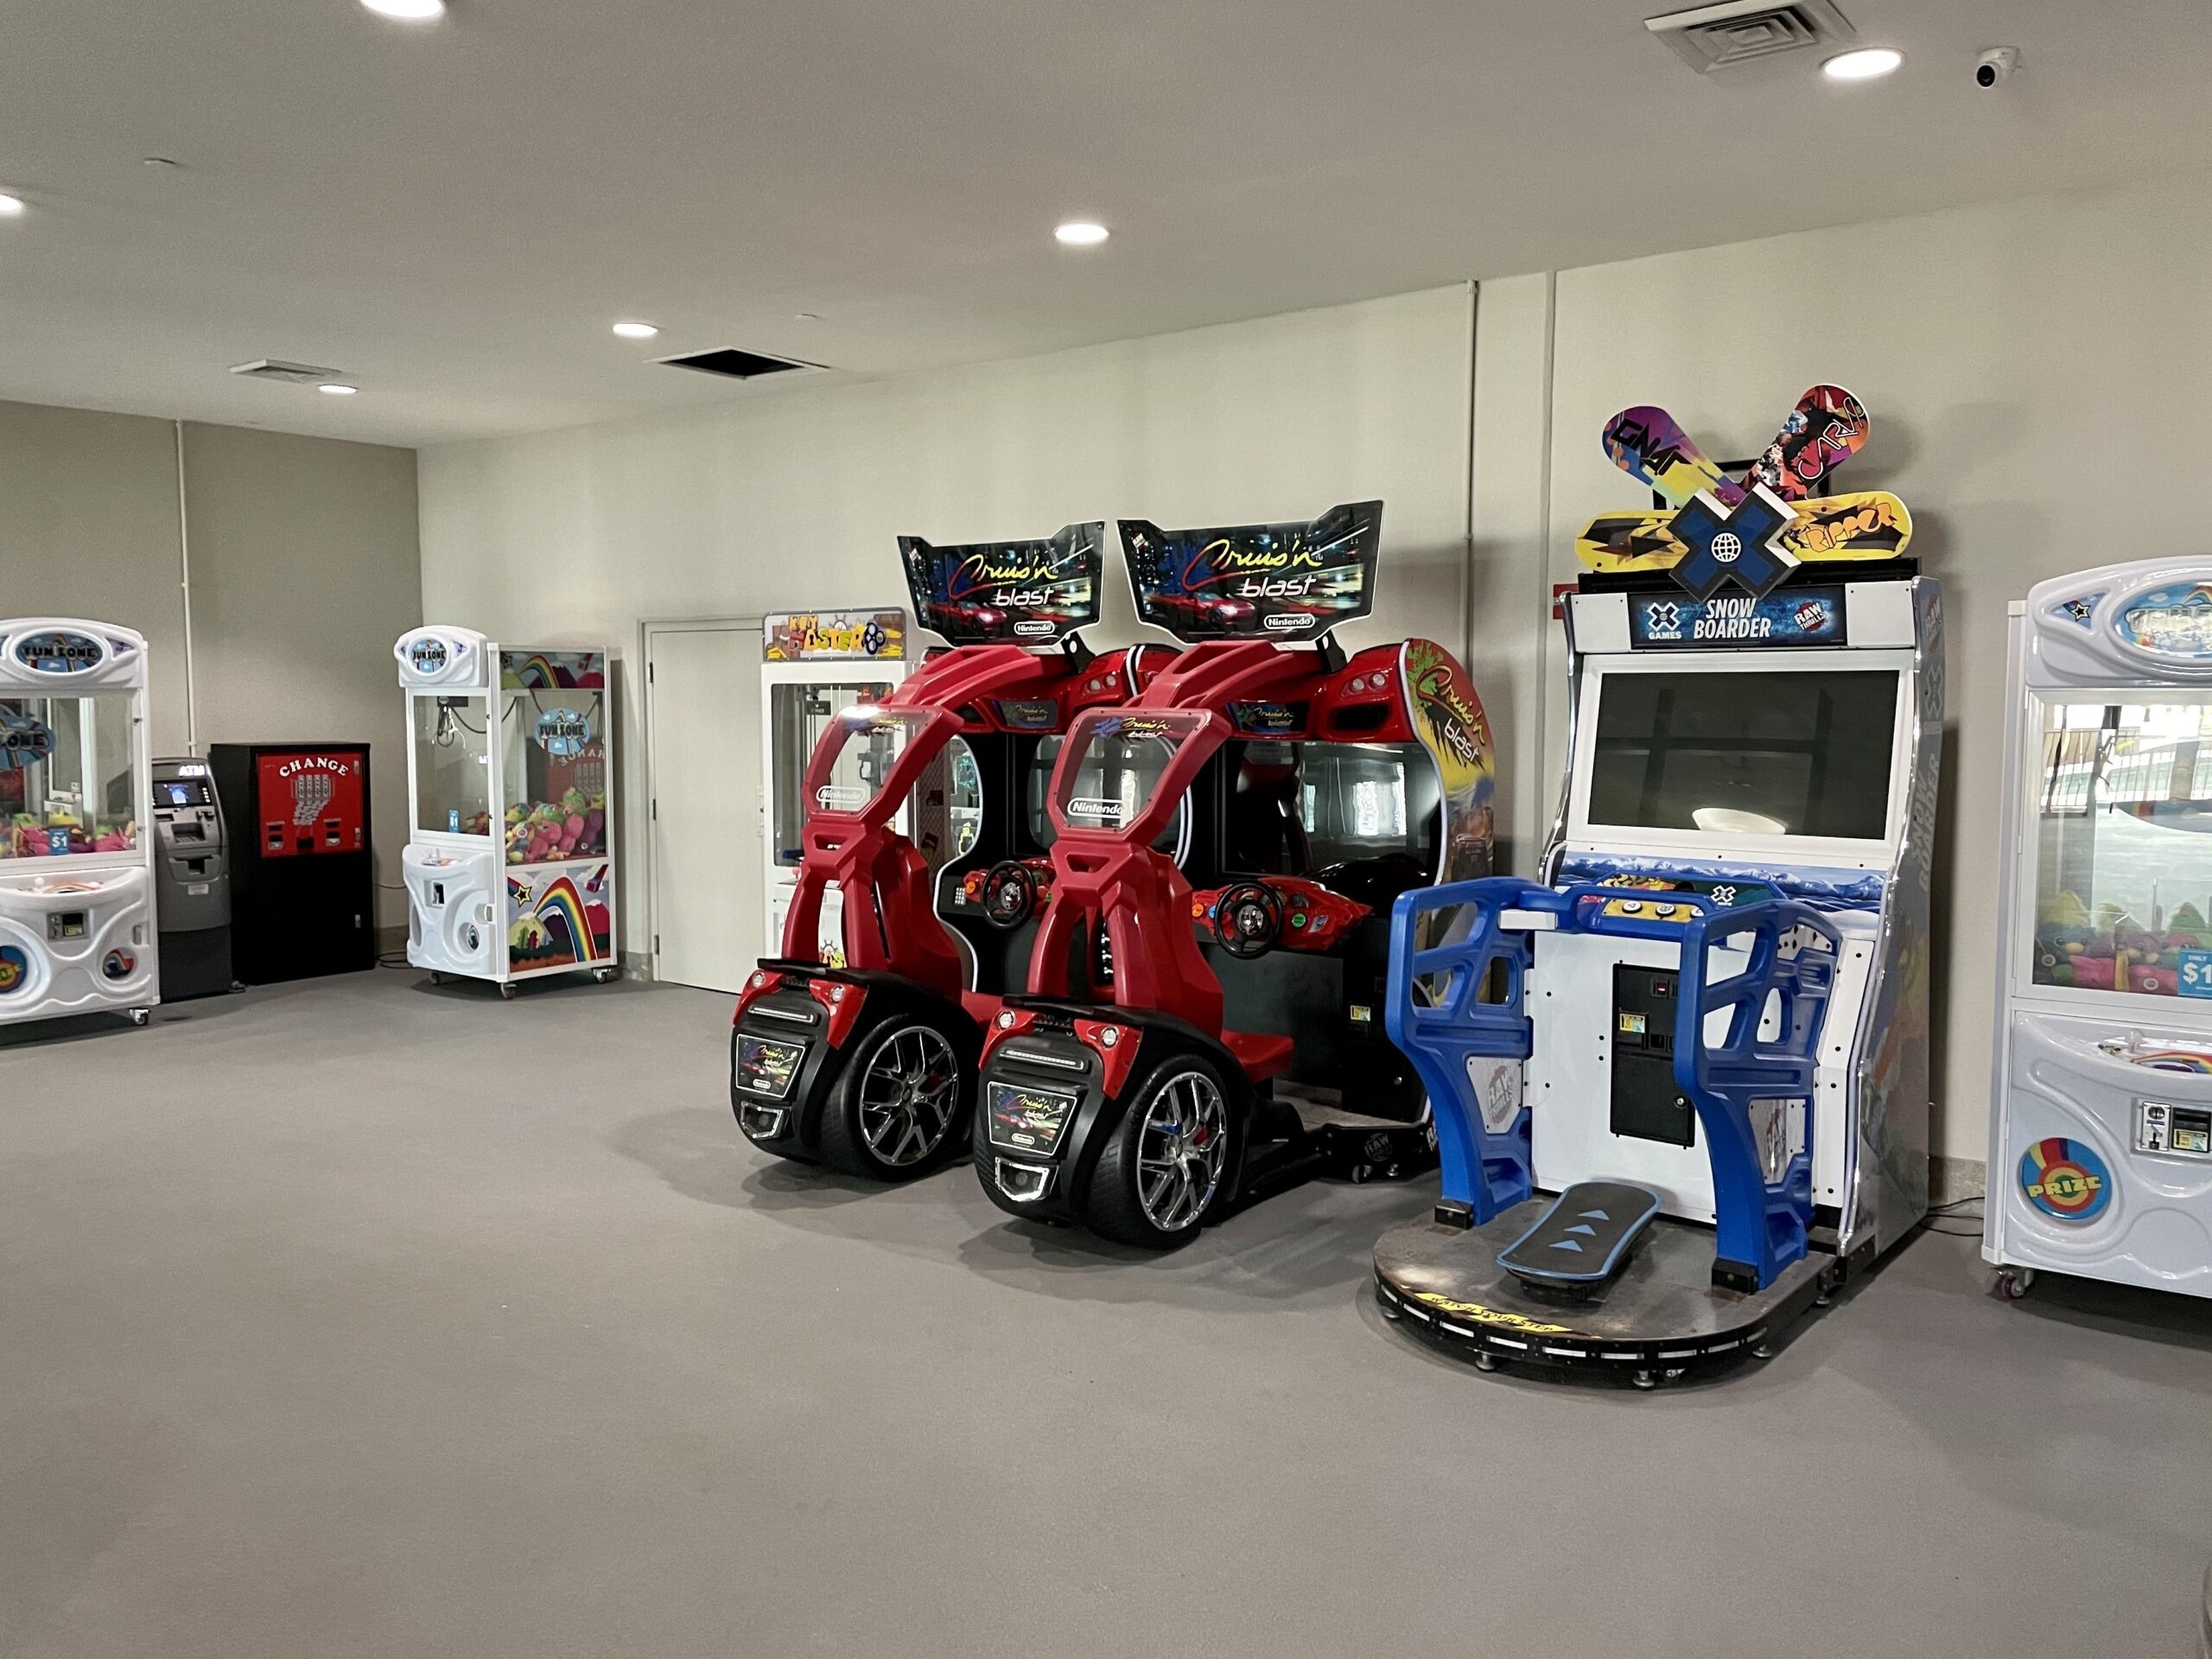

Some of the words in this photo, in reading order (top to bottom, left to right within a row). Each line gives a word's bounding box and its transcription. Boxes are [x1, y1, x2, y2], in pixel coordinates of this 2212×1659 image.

[1806, 501, 1897, 553] RIPPER
[1180, 538, 1323, 591] Cruis'n
[948, 553, 1058, 601] Cruis'n
[1240, 575, 1317, 597] blast
[995, 586, 1055, 606] blast
[1705, 597, 1758, 620] SNOW
[1794, 602, 1822, 625] RAW
[1016, 624, 1052, 634] Nintendo
[1267, 616, 1311, 628] Nintendo
[1693, 617, 1772, 639] BOARDER
[1648, 631, 1682, 640] GAMES
[23, 646, 54, 658] FUN
[58, 645, 97, 658] ZONE
[559, 723, 585, 736] ZONE
[1444, 717, 1479, 762] blast
[178, 765, 206, 776] ATM
[279, 757, 349, 777] CHANGE
[52, 836, 67, 848] $1
[2183, 962, 2212, 985] $1
[1487, 1070, 1511, 1109] RAW
[2027, 1176, 2102, 1198] PRIZE
